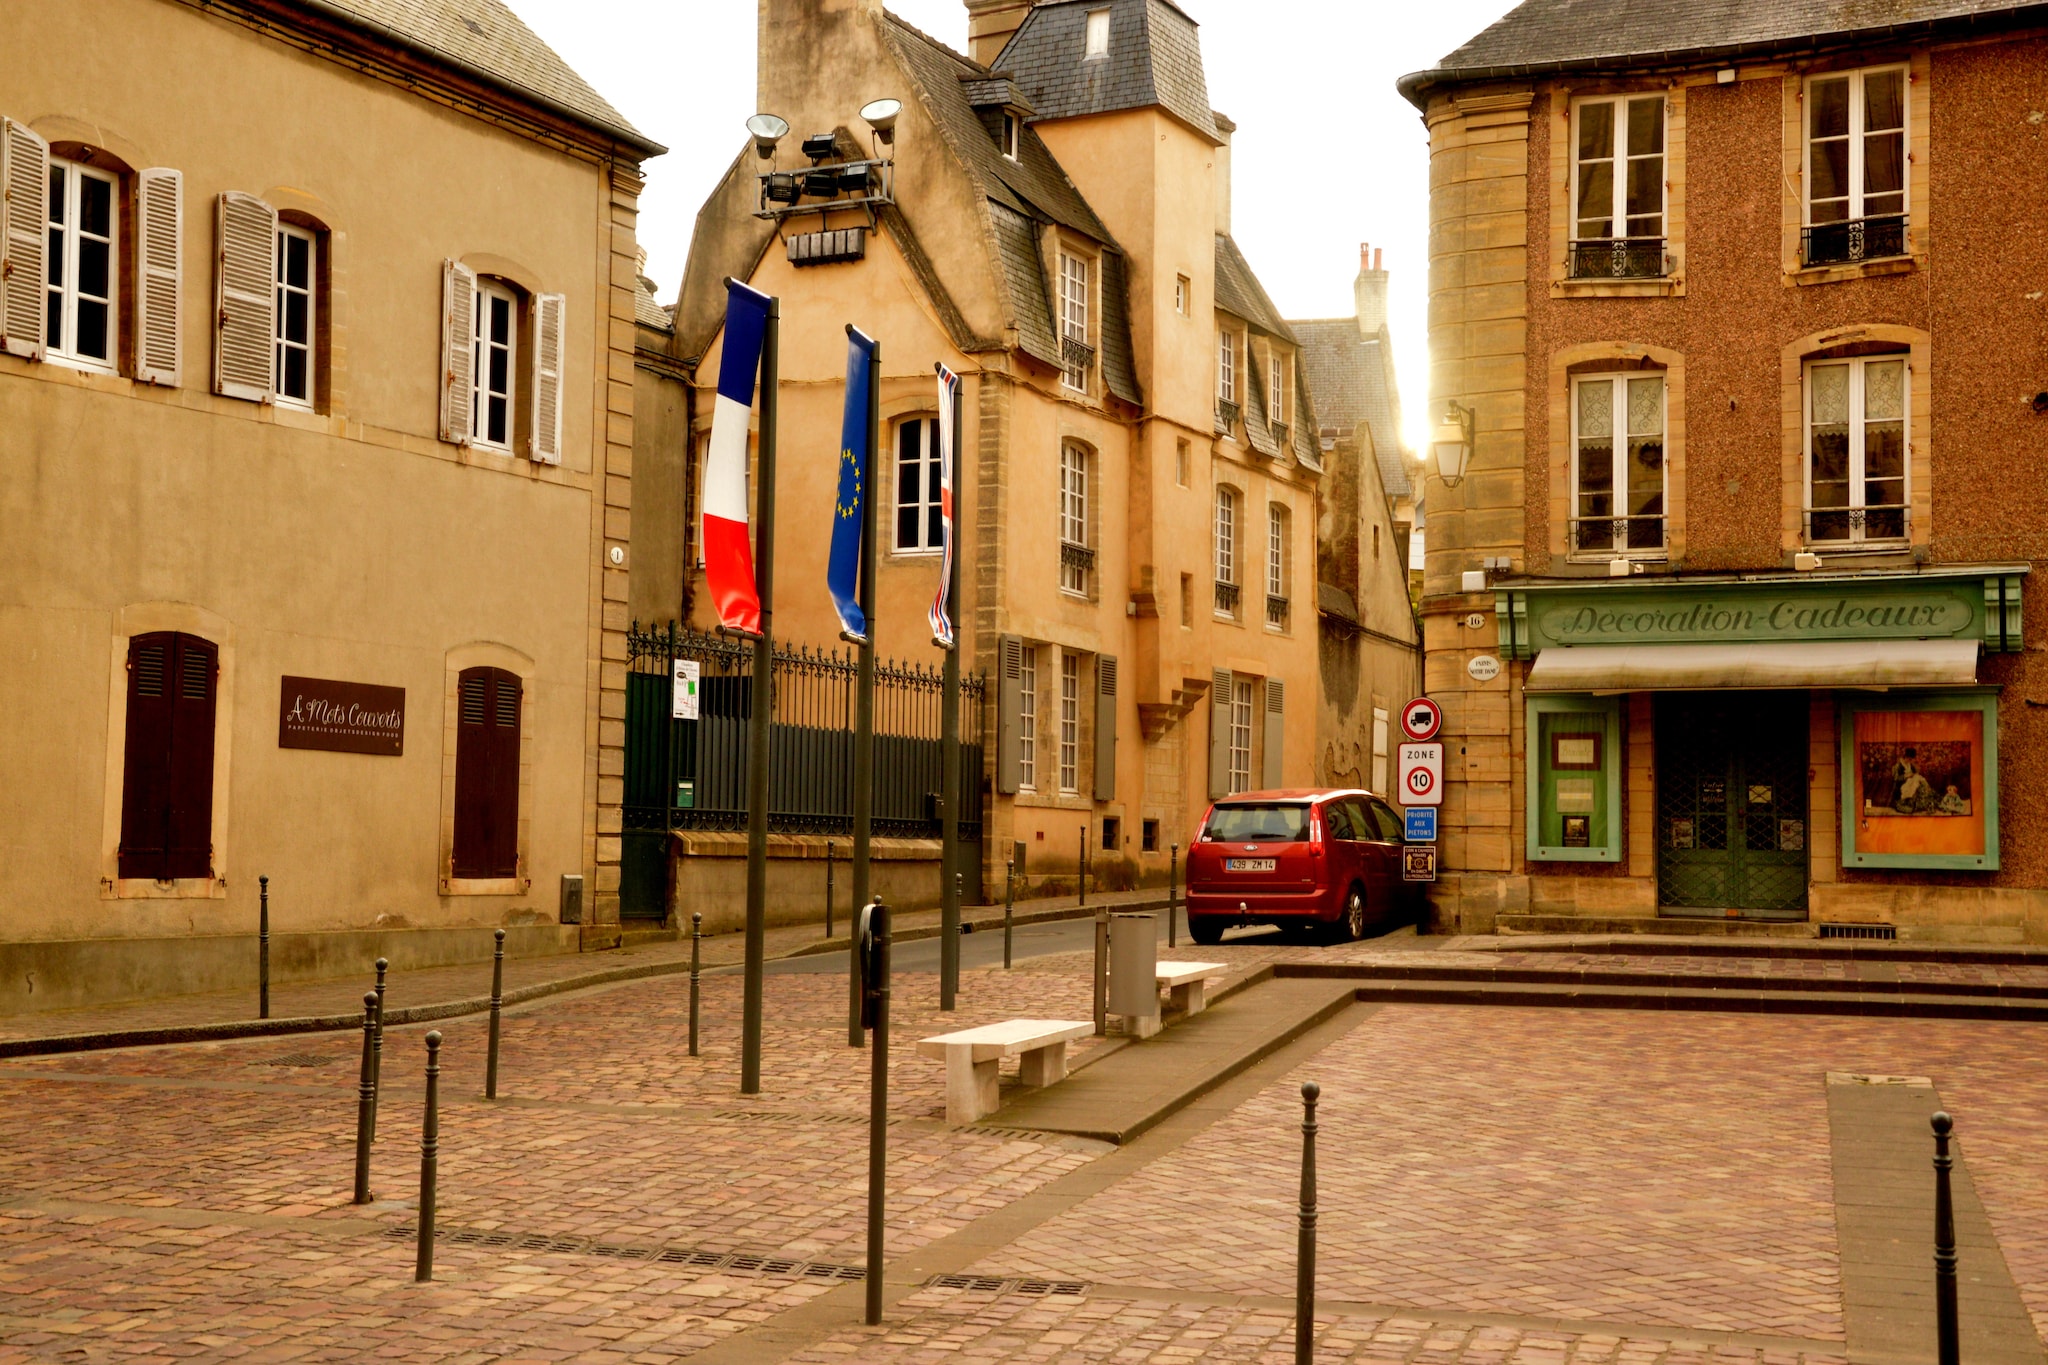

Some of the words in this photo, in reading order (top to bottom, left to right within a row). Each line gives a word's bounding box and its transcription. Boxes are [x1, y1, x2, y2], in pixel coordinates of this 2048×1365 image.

[1470, 617, 1481, 626] 16
[306, 699, 345, 725] Mots
[348, 703, 400, 730] Couverts
[287, 725, 328, 733] PAPETERIE
[1407, 750, 1435, 760] ZONE
[1412, 774, 1428, 787] 10
[1231, 860, 1246, 869] 439
[1252, 861, 1262, 869] ZM
[1264, 861, 1273, 869] 14
